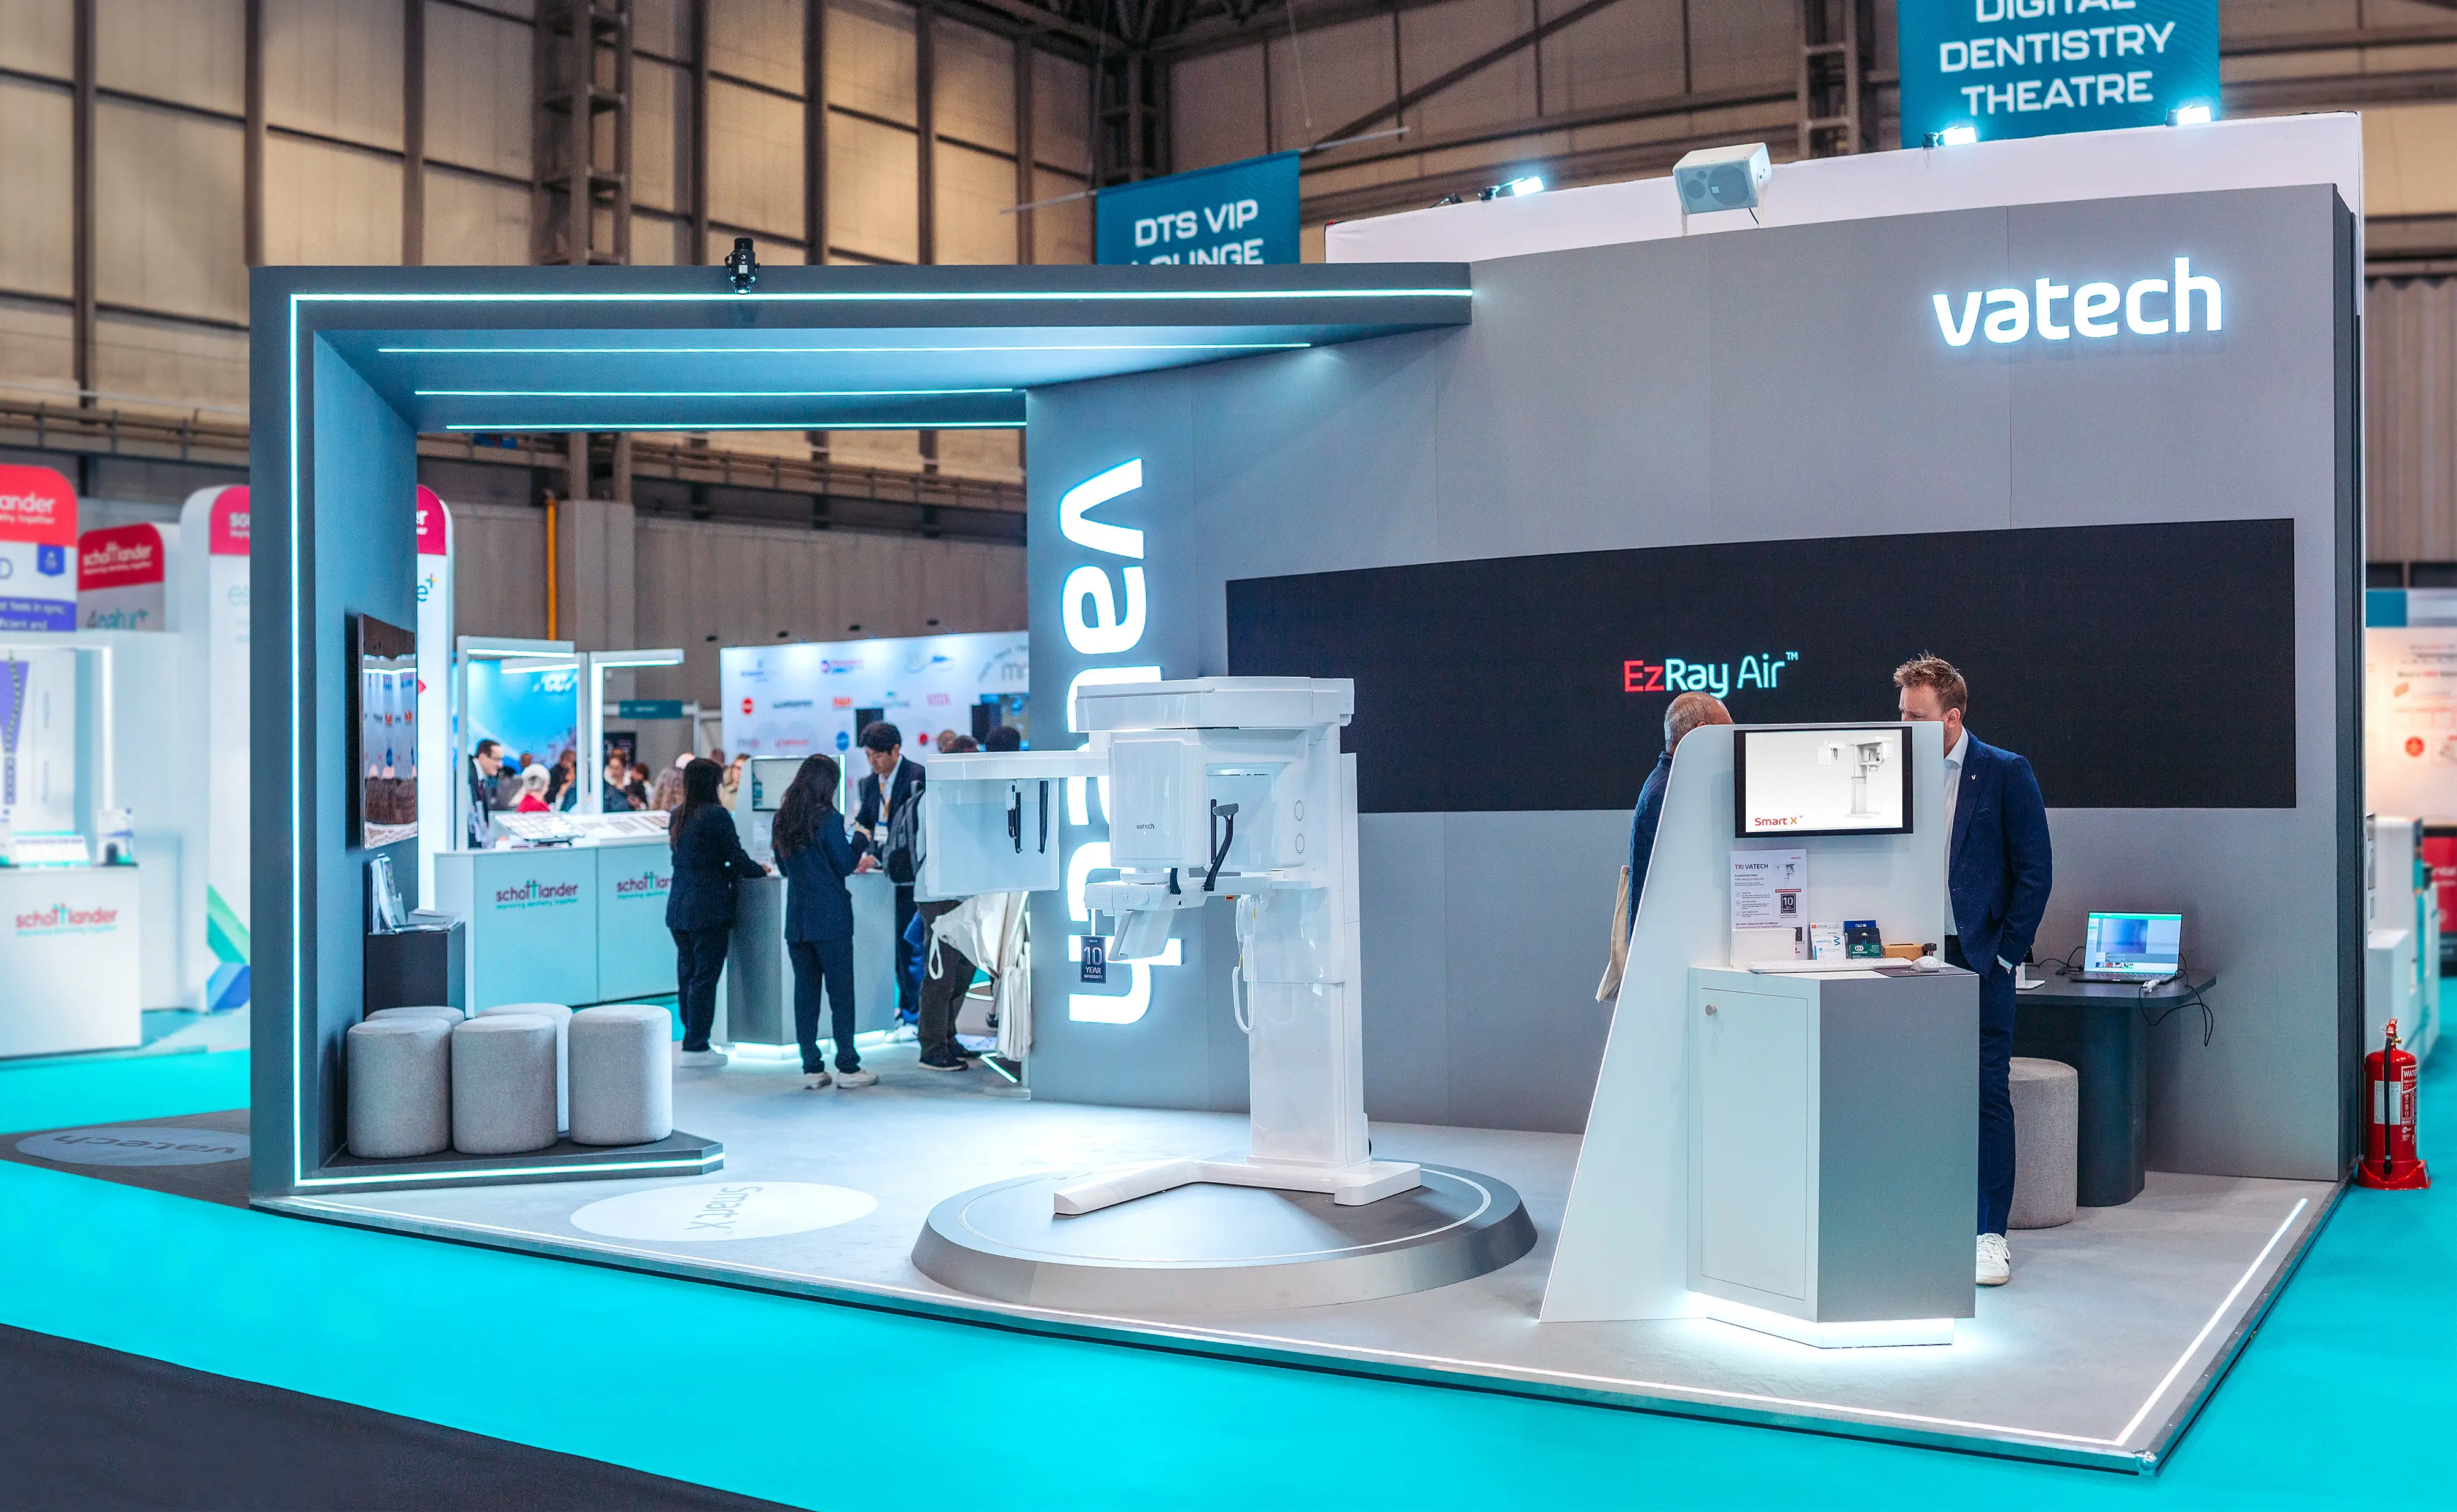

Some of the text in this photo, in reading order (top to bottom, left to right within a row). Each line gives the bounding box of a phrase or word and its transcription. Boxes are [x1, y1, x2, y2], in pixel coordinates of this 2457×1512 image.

[1940, 21, 2176, 73] DENTISTRY
[1961, 71, 2154, 116] THEATRE
[1135, 198, 1259, 247] DTS VIP
[1932, 256, 2222, 347] vatech
[1624, 658, 1729, 699] EzRay
[1060, 458, 1182, 1025] vach
[1755, 817, 1787, 826] Smart
[1783, 897, 1794, 906] 10
[1084, 946, 1102, 965] 10
[1085, 965, 1101, 974] YEAR
[53, 1135, 236, 1154] vatech
